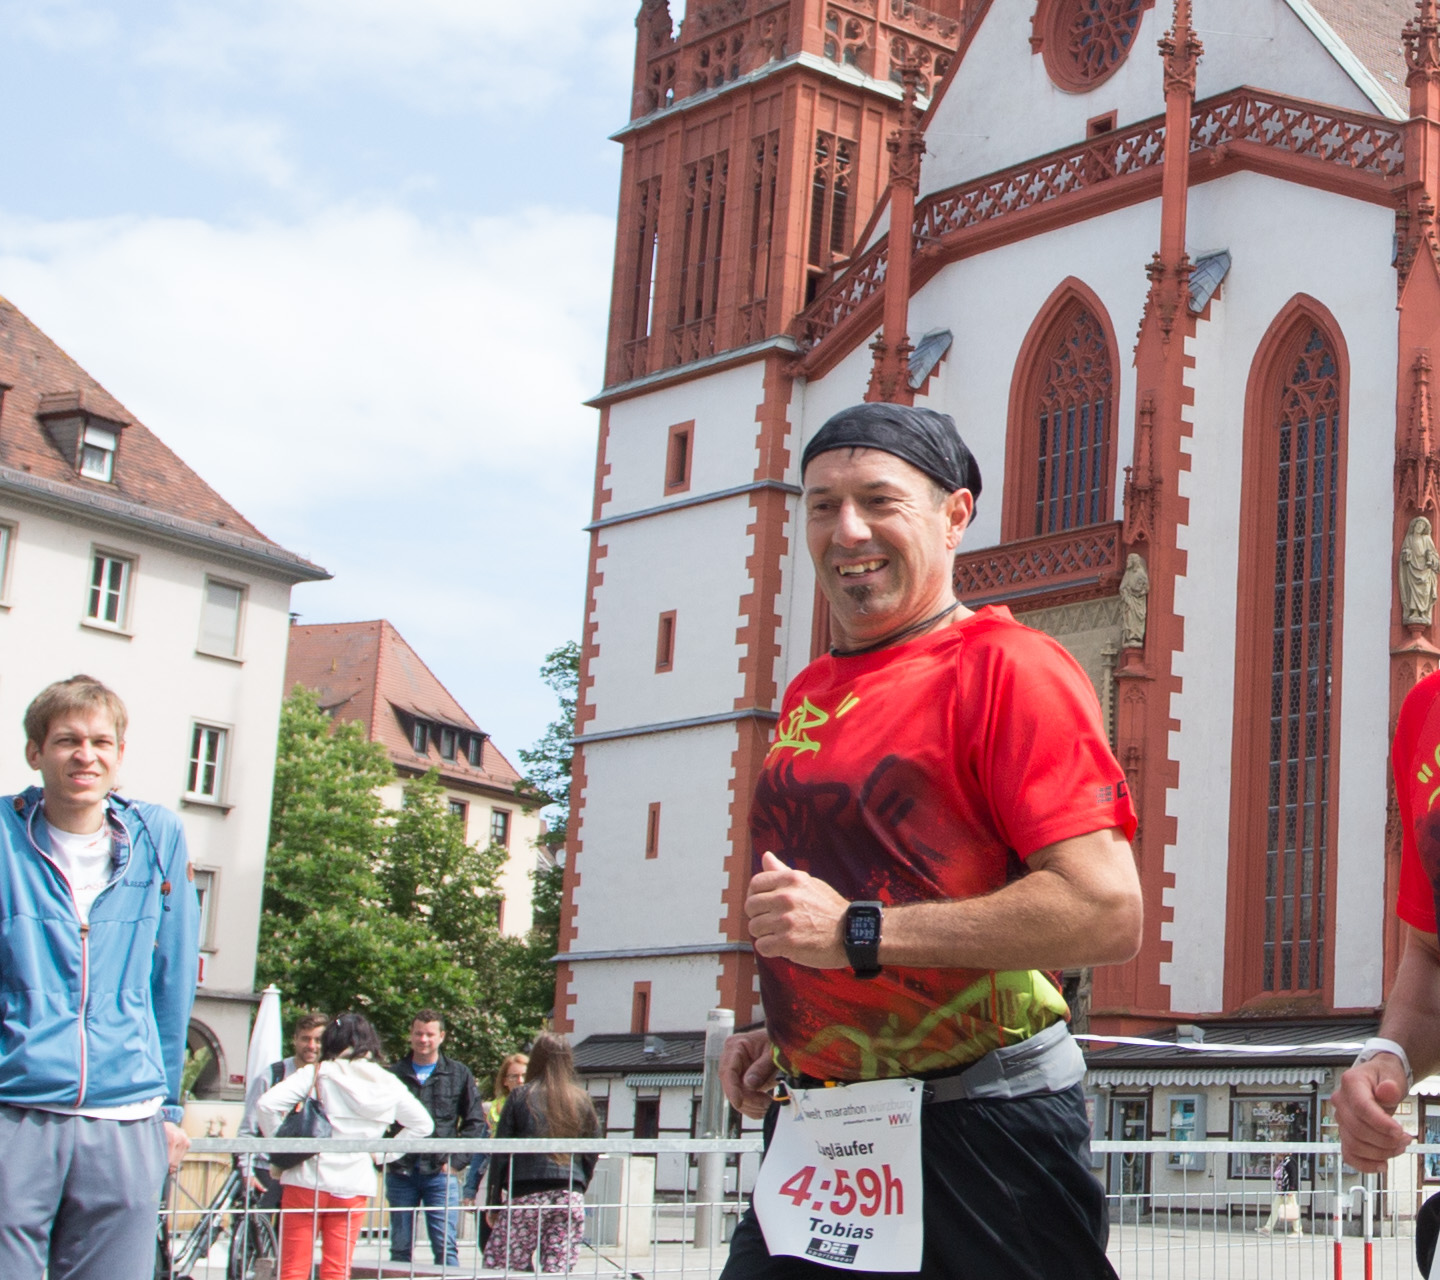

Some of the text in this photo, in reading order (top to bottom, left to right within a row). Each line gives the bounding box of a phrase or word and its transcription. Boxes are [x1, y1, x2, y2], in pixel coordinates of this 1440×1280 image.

[825, 1104, 867, 1118] marathon
[816, 1140, 874, 1160] ugläufer
[778, 1164, 904, 1216] 4:59h
[809, 1217, 874, 1239] Tobias
[819, 1240, 849, 1256] DEE
